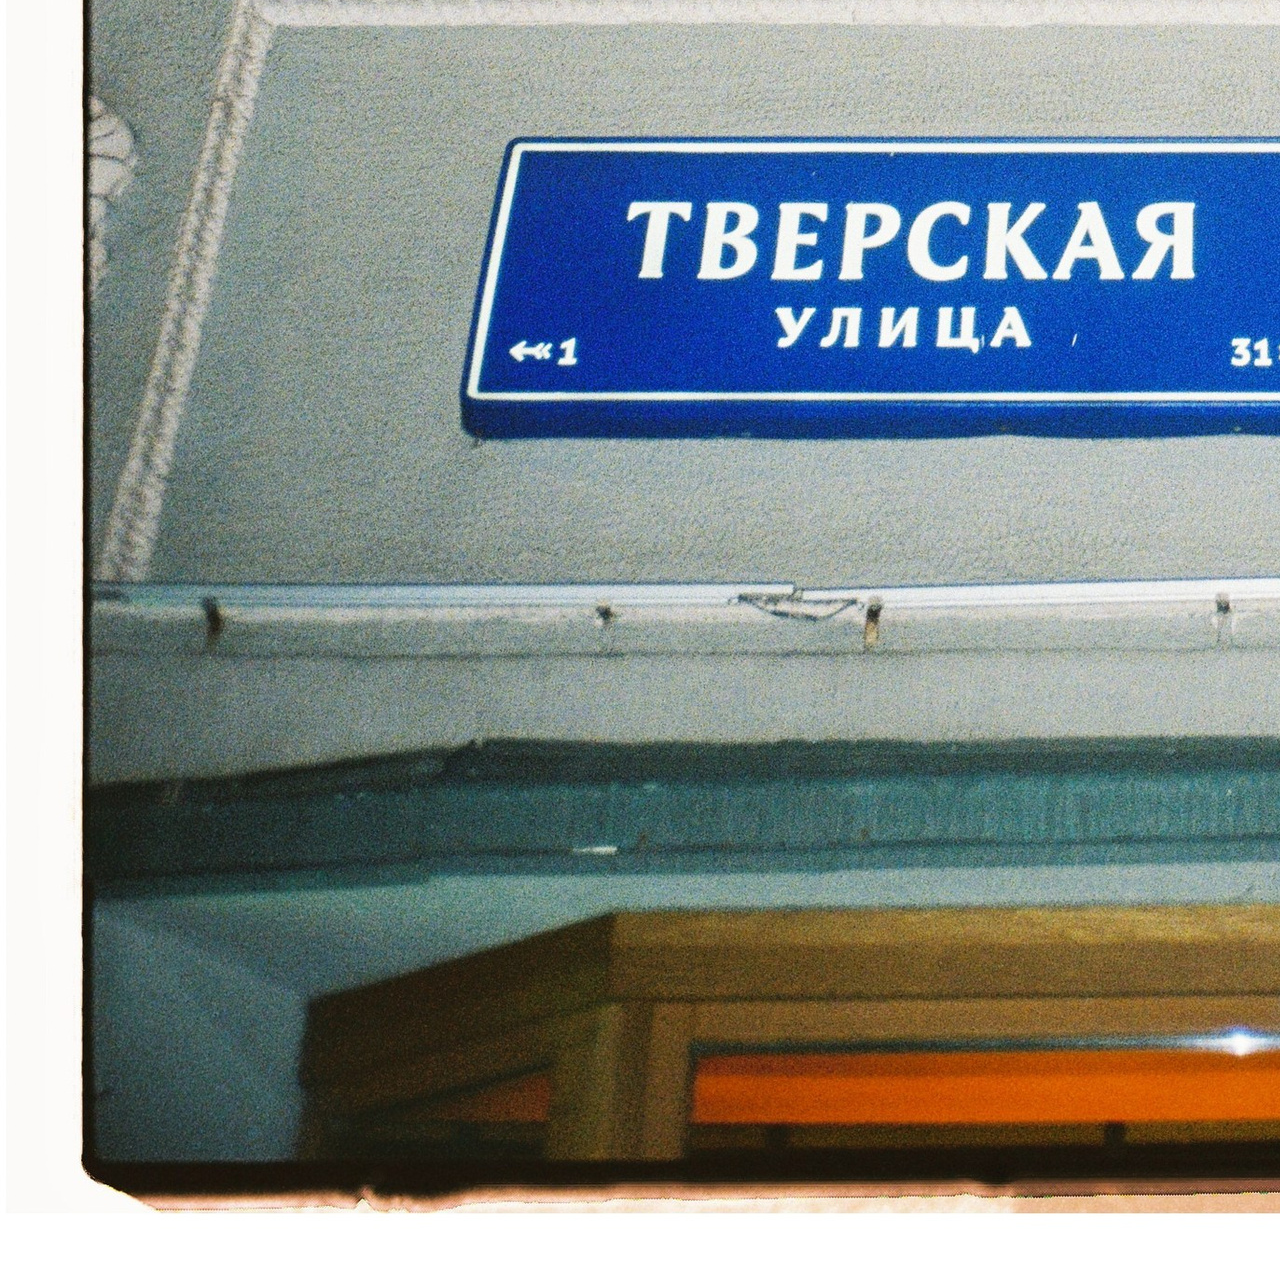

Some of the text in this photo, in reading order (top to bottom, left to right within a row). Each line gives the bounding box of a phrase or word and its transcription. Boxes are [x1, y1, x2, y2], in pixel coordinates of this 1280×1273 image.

[626, 200, 1196, 282] ТВЕРСКАЯ
[775, 306, 1032, 354] УЛИЦА
[556, 337, 578, 366] 1
[1230, 337, 1273, 367] 31
